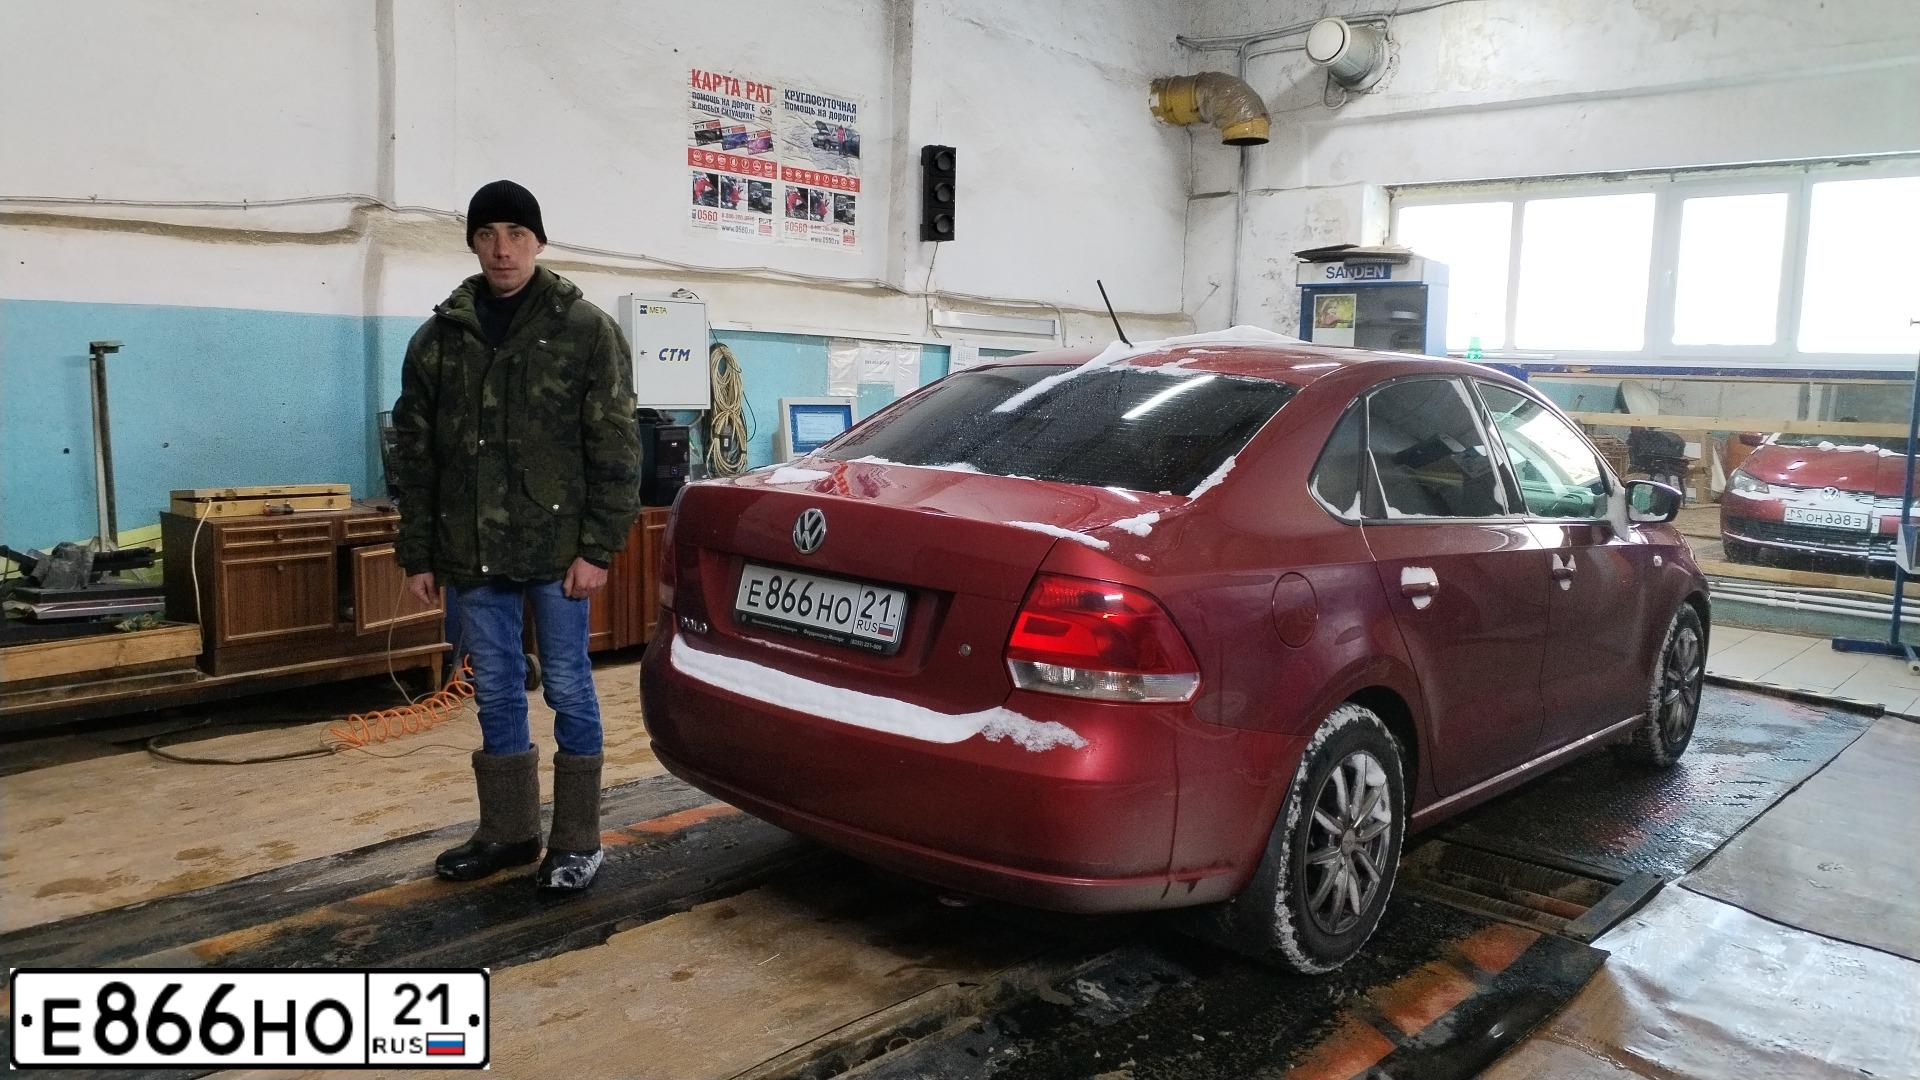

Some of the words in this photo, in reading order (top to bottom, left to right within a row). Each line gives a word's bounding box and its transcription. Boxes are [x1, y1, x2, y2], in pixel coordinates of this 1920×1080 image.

[691, 68, 741, 97] КАРТА
[746, 81, 773, 104] РАТ
[692, 91, 720, 105] ПОМОЩЬ
[721, 97, 731, 107] НА
[731, 100, 756, 112] ДОРОГЕ
[784, 88, 857, 115] КРУГЛОСУТОЧНАЯ
[784, 101, 816, 116] помощь
[817, 109, 827, 118] на
[828, 111, 857, 124] дороге!
[697, 209, 718, 222] 0560
[789, 221, 808, 234] 0560
[1326, 265, 1385, 280] SANDEN
[658, 347, 691, 362] СТМ
[860, 590, 894, 622] 21
[856, 619, 878, 633] RUS
